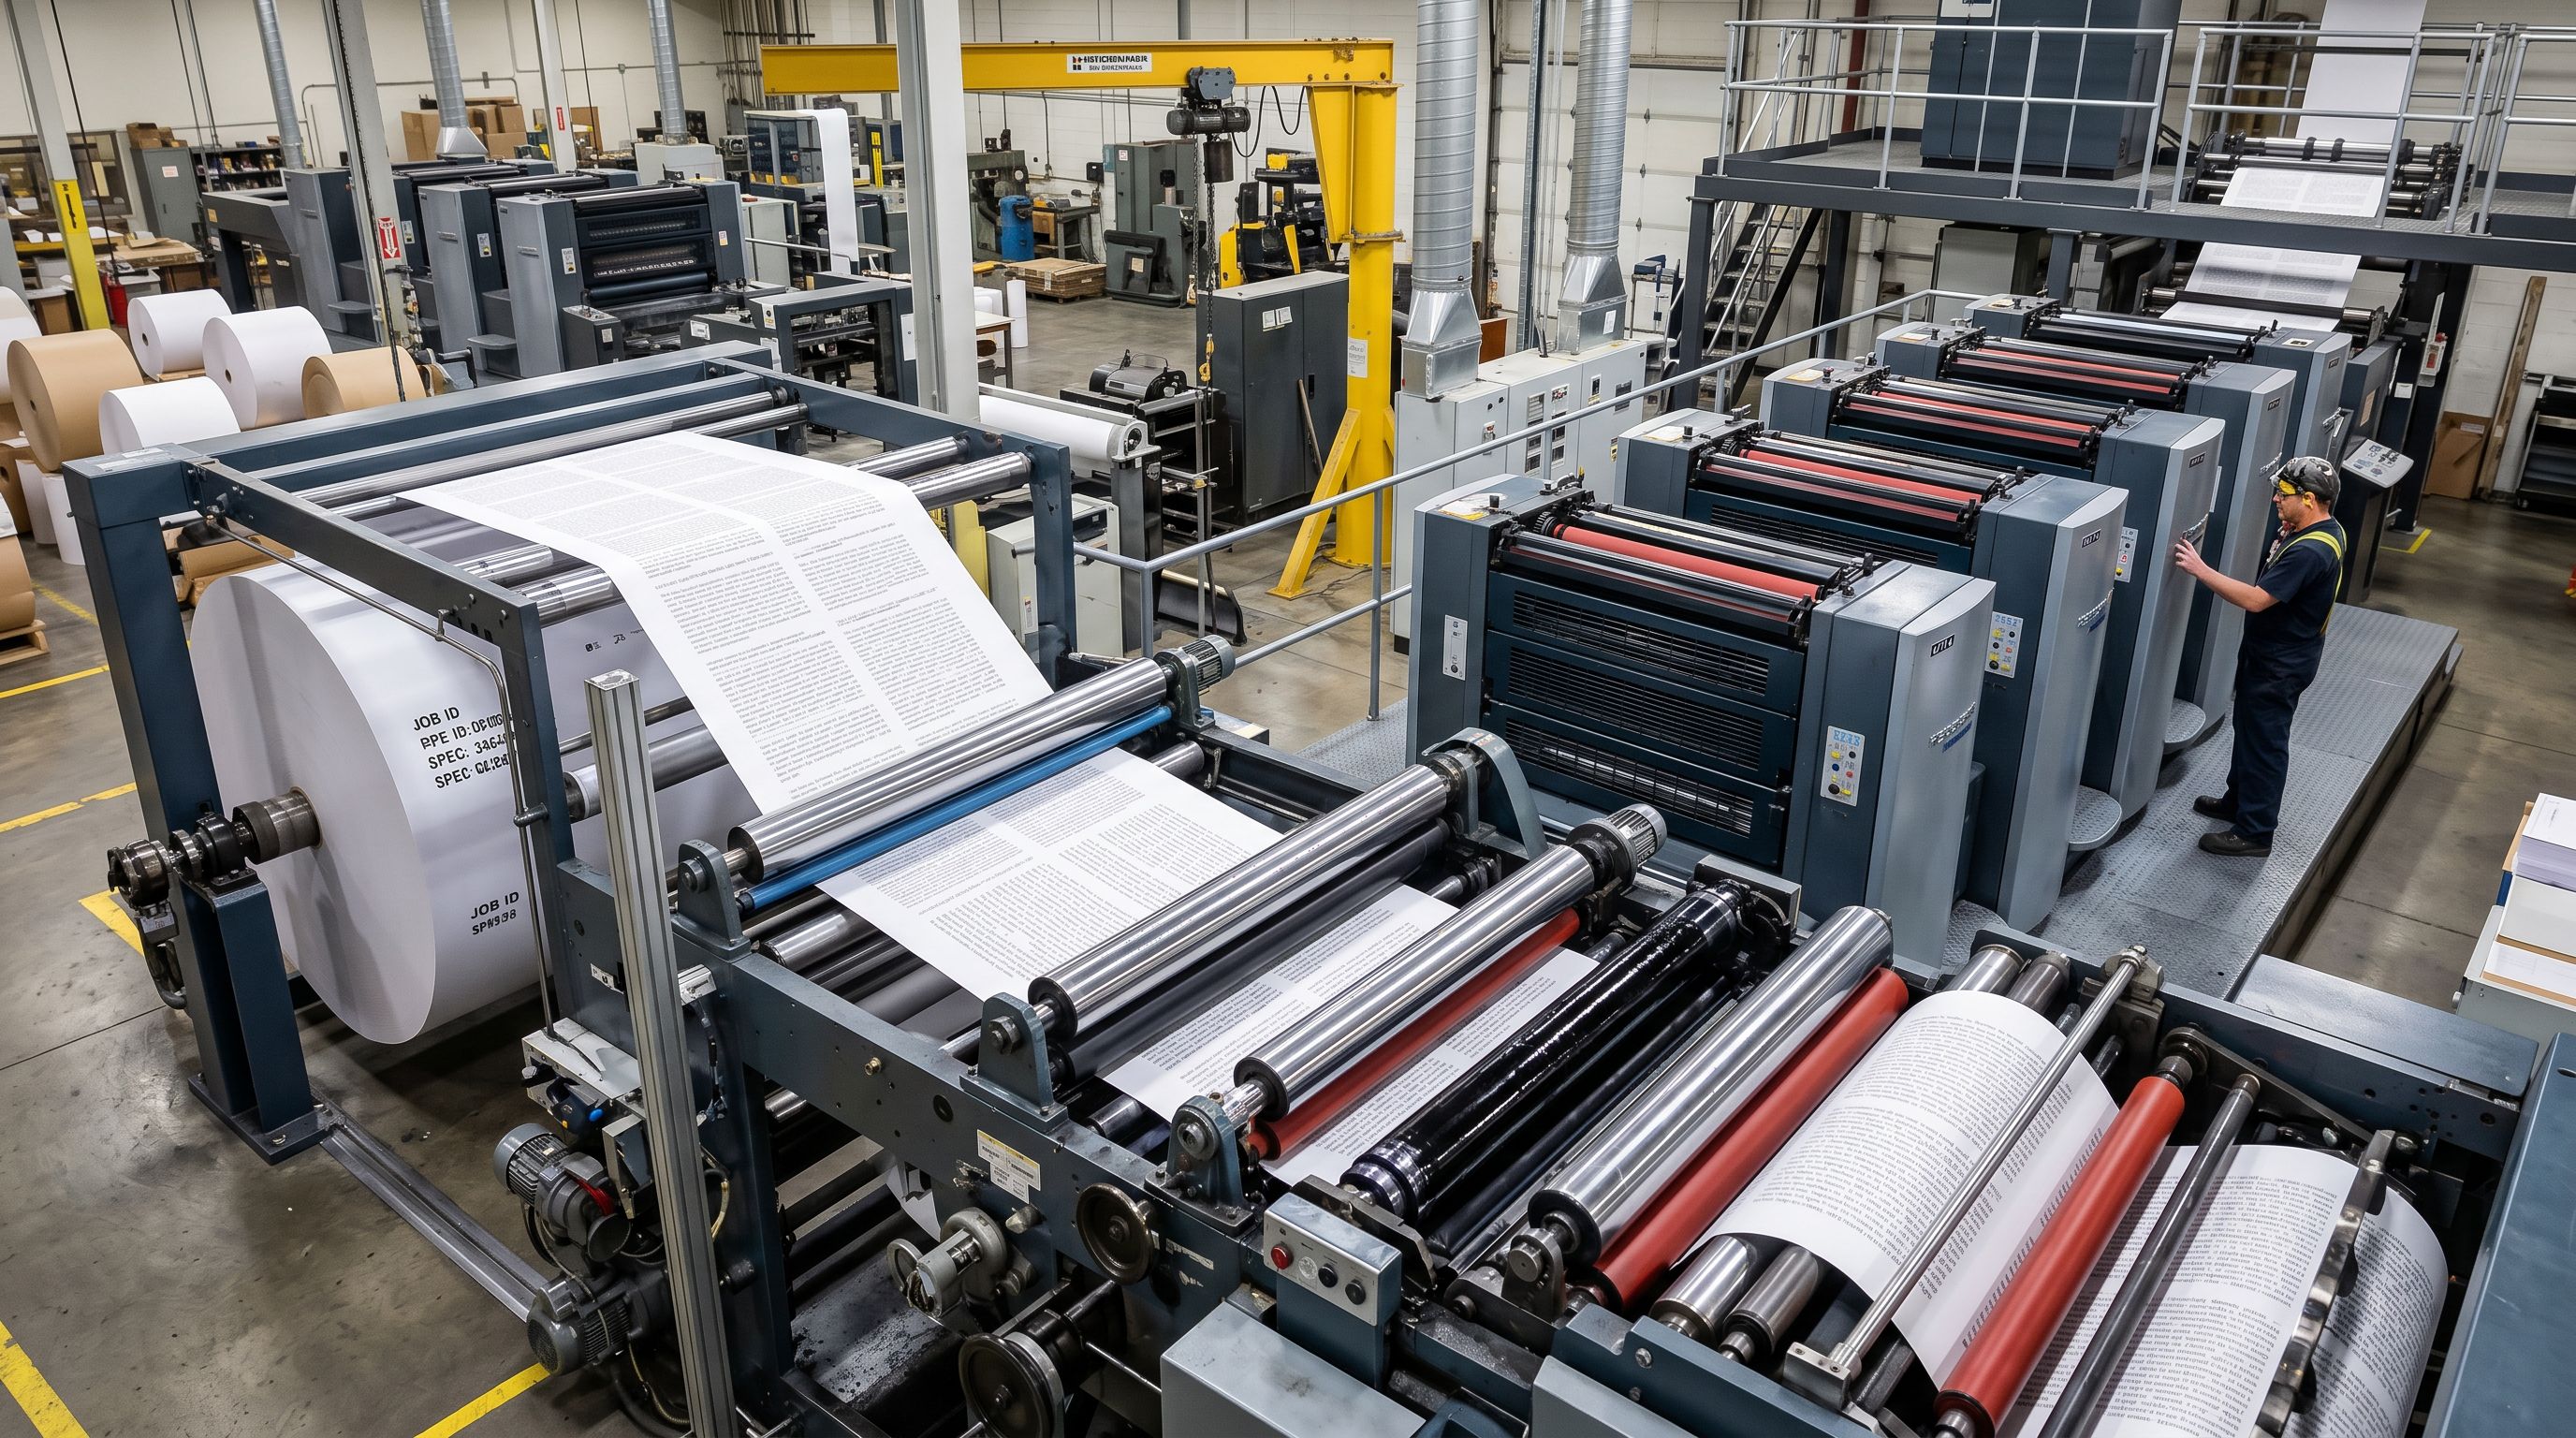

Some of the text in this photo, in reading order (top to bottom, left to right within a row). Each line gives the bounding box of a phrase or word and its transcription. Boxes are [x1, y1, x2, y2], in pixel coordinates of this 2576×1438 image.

[414, 707, 460, 731] JOB ID
[471, 891, 520, 919] JOB ID
